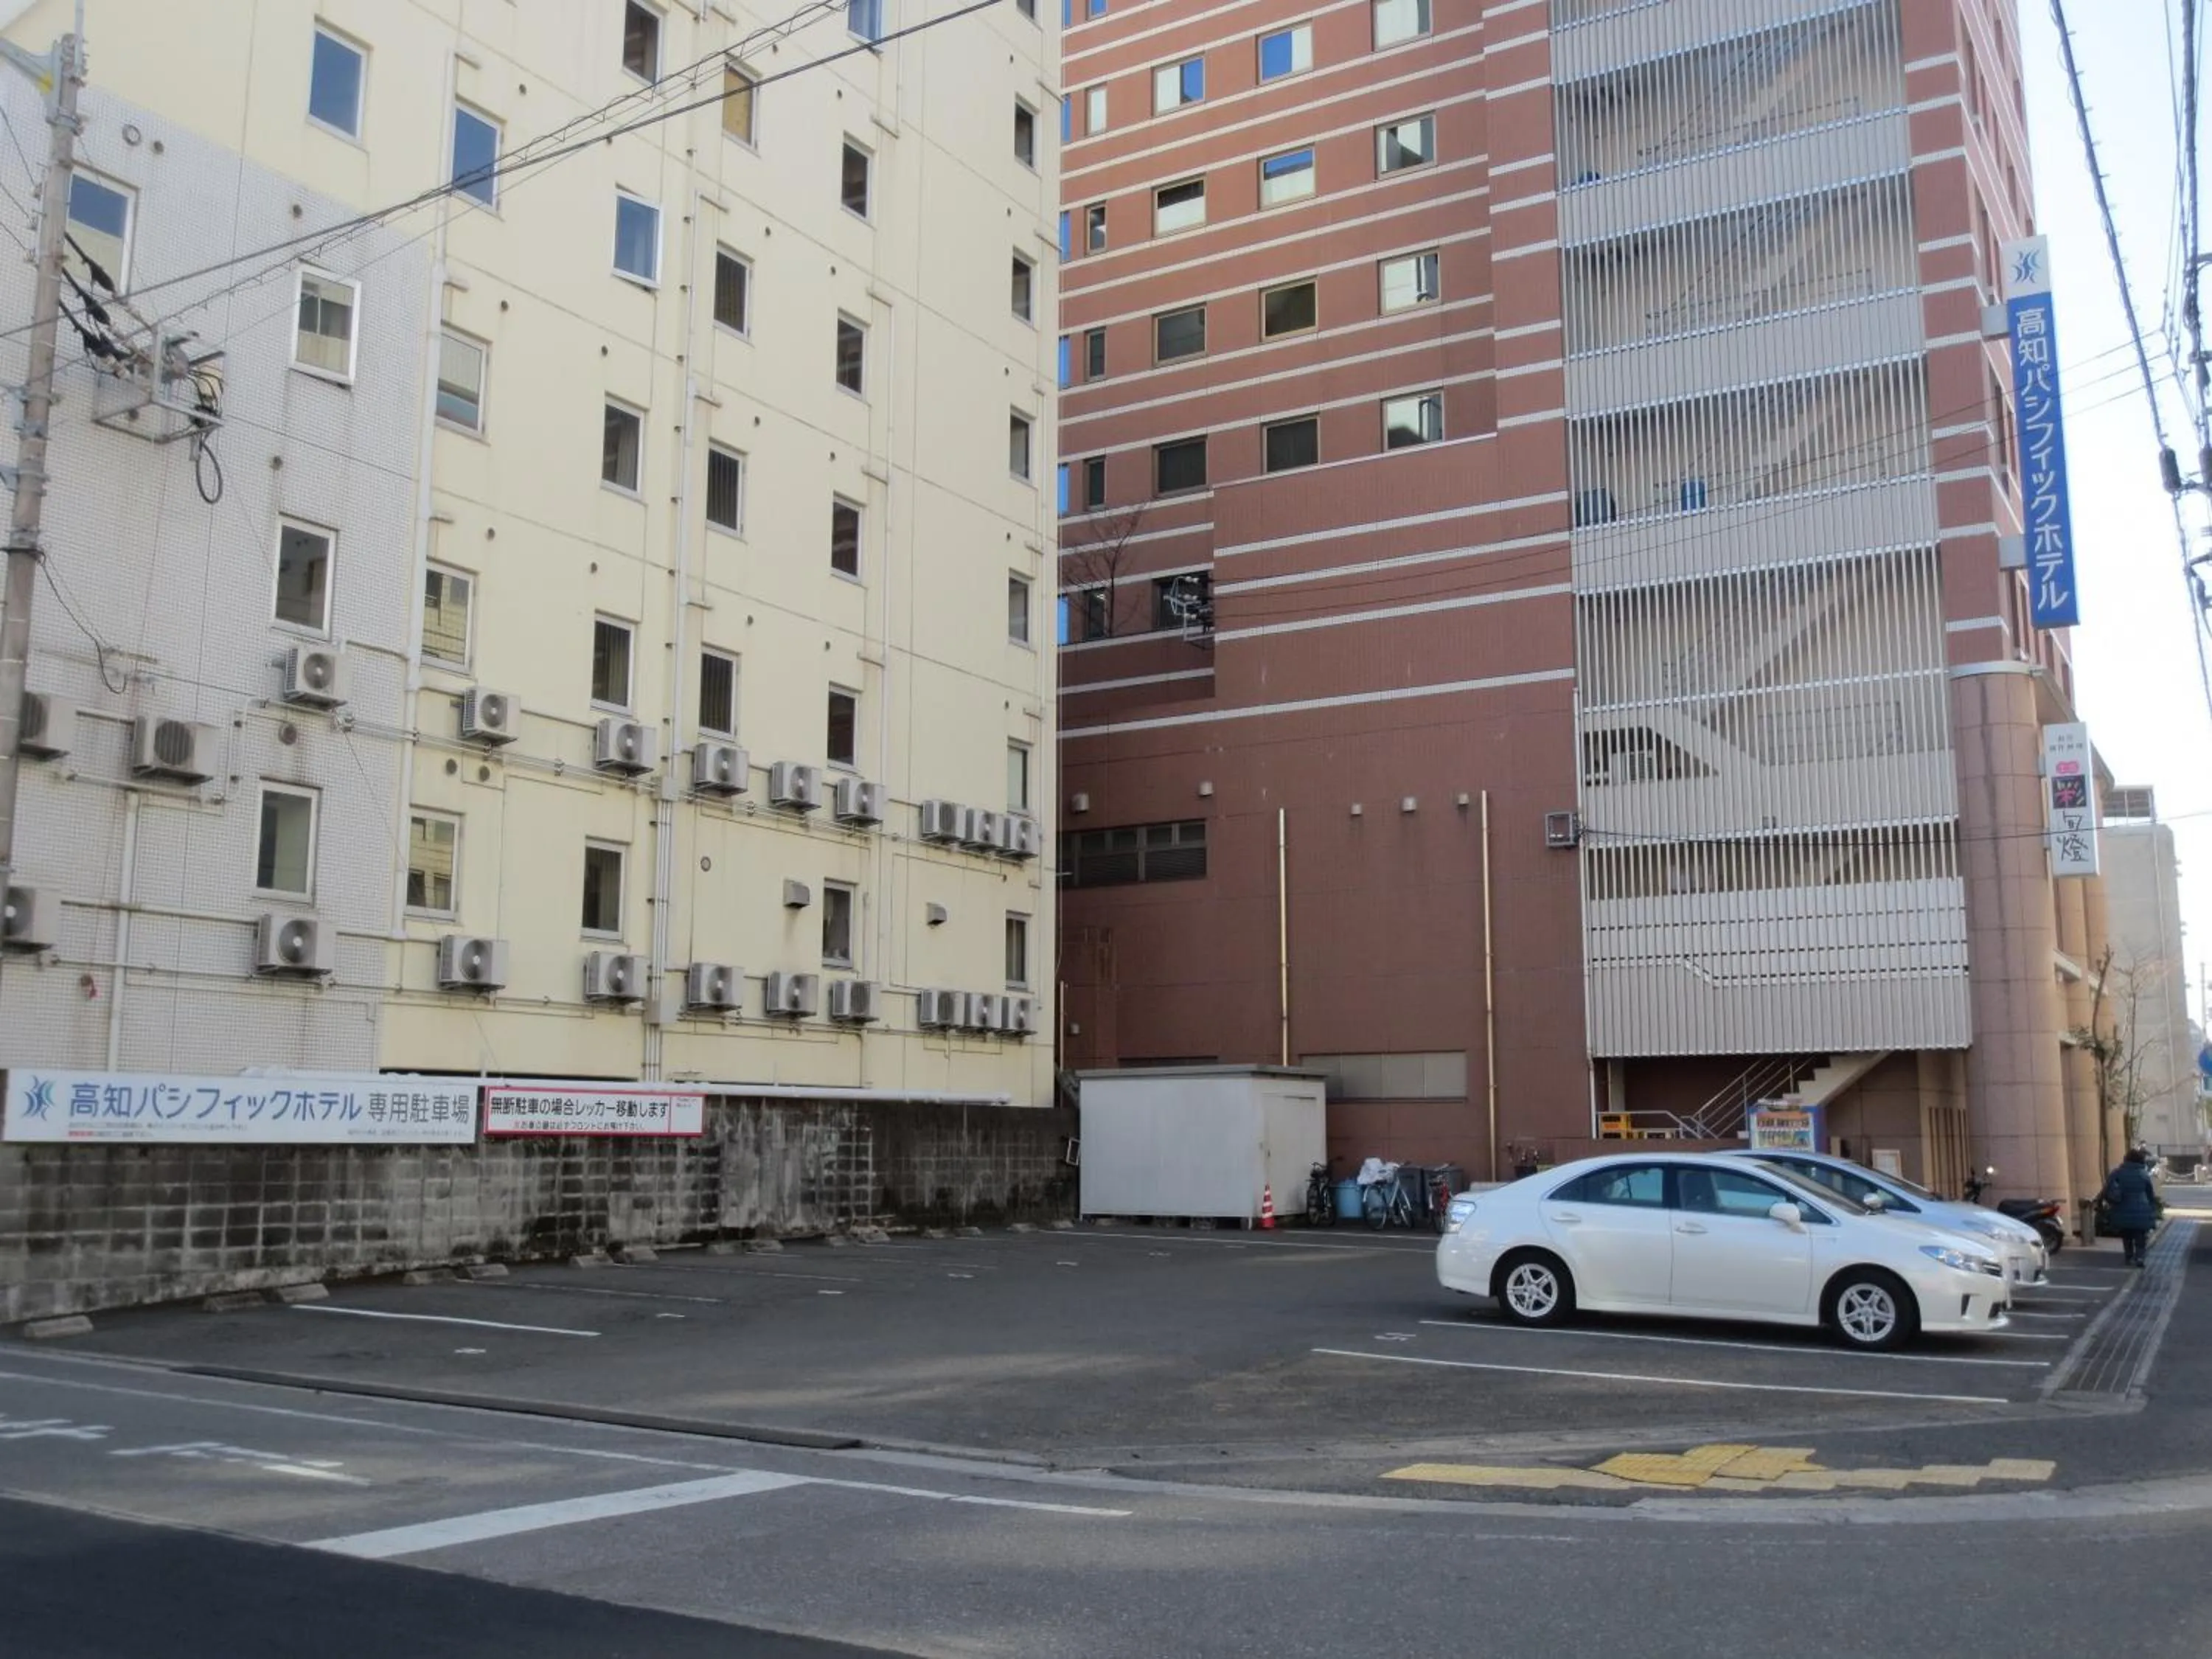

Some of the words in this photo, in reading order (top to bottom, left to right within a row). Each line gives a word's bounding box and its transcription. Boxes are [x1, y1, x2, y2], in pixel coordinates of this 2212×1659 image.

[2015, 308, 2069, 611] 高知パシフィックホテル
[69, 1082, 362, 1121] 高知パシフィックホテル
[368, 1092, 470, 1124] 専用駐車場
[490, 1096, 669, 1118] 無断駐車の場合レッカー移動します
